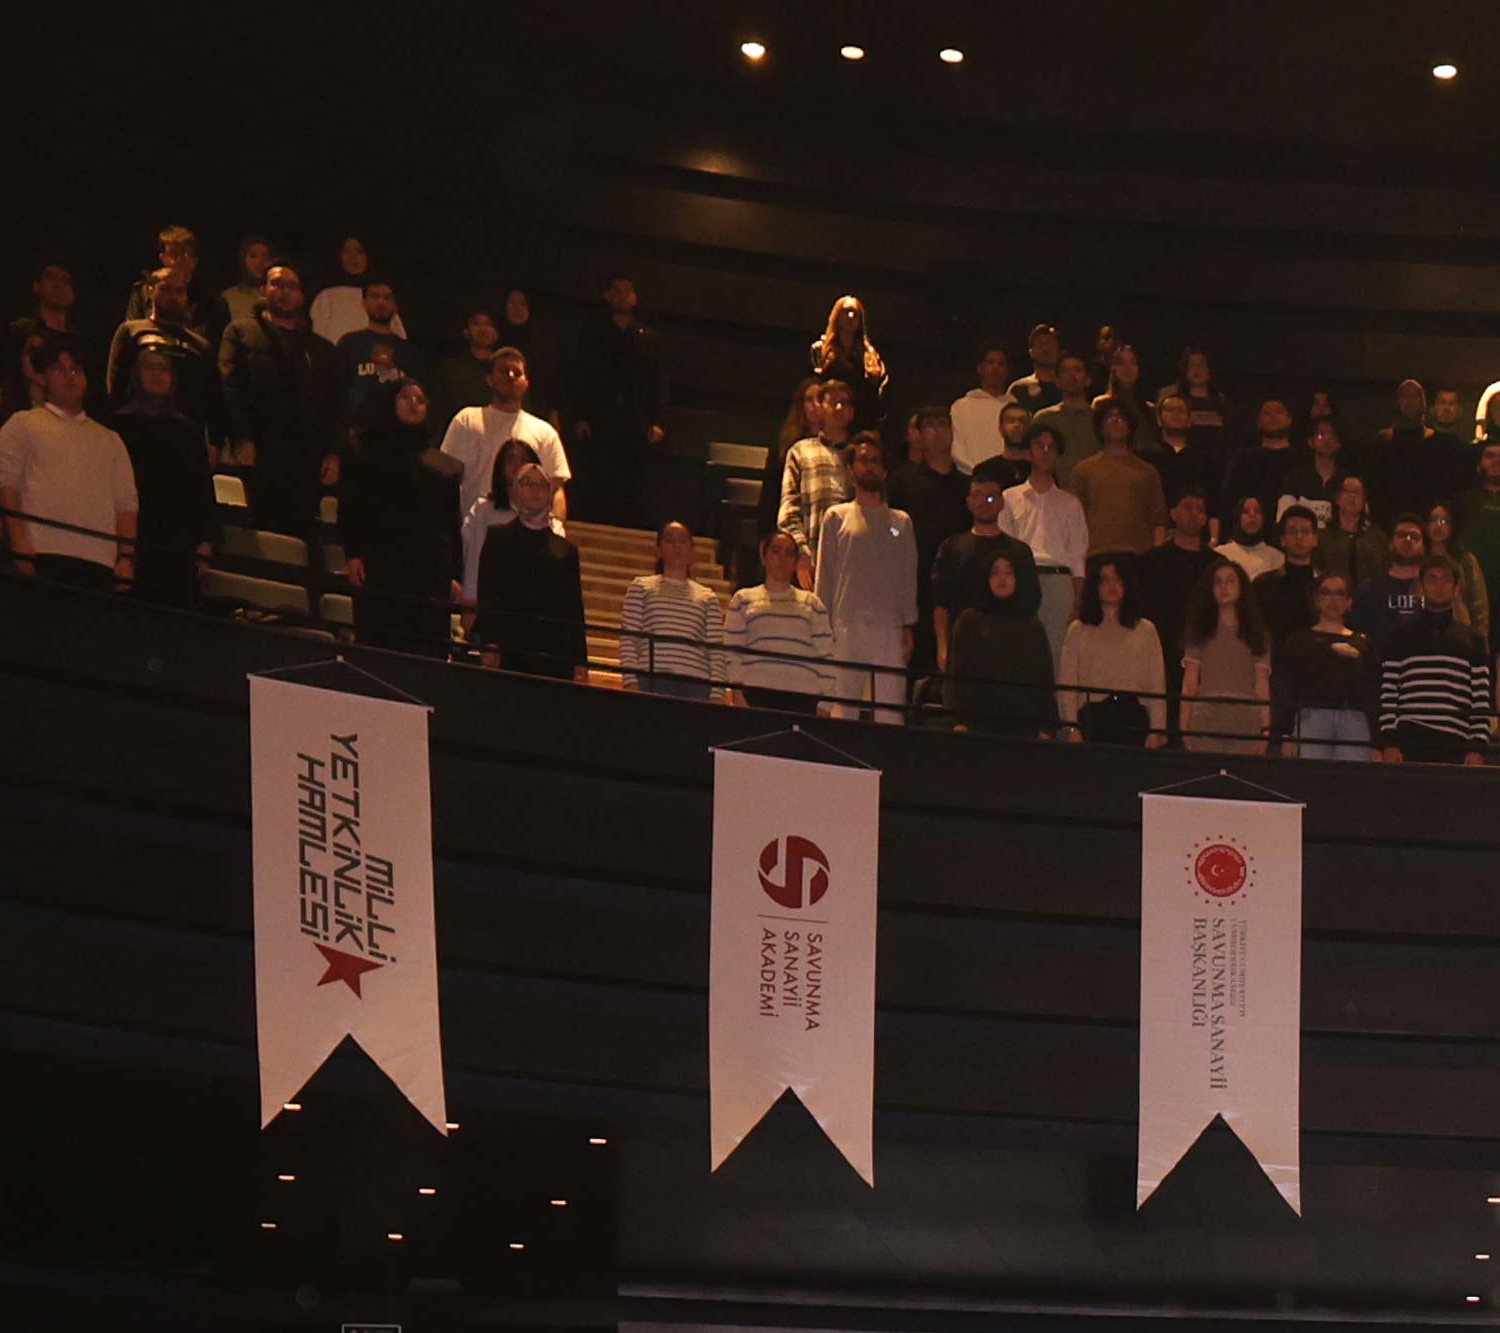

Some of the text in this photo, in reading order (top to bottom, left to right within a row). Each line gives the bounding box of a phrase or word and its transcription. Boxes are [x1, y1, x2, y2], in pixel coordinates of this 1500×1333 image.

[759, 927, 779, 1018] AKADEMİ
[805, 931, 823, 1032] SAVUNMA
[1191, 918, 1208, 1027] BAŞKANLIĞI
[1210, 918, 1228, 1090] SAVUNMA SANAYİİ
